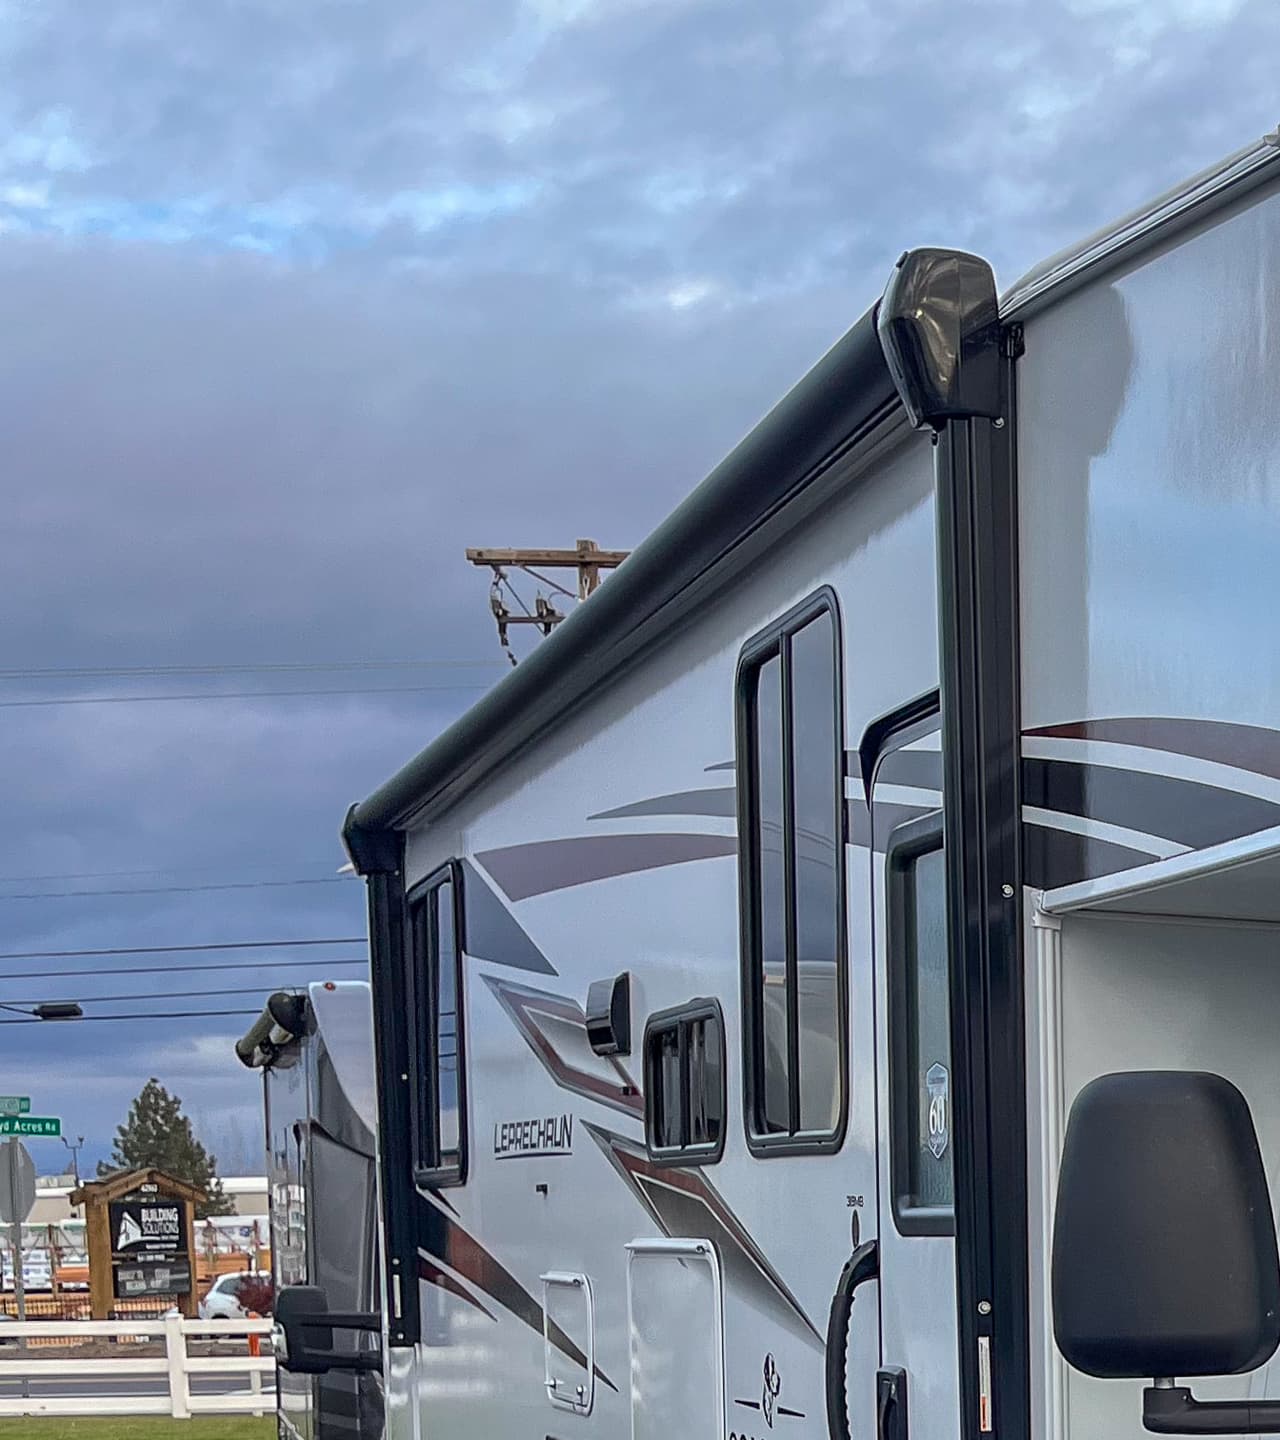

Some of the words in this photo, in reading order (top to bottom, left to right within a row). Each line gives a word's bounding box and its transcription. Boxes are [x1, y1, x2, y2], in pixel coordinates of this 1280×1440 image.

[929, 1095, 945, 1134] 60
[13, 1120, 43, 1133] Acres
[494, 1113, 573, 1153] LEPRECHAUN
[141, 1207, 179, 1221] BUILDING
[141, 1221, 180, 1235] SOLUTIONS
